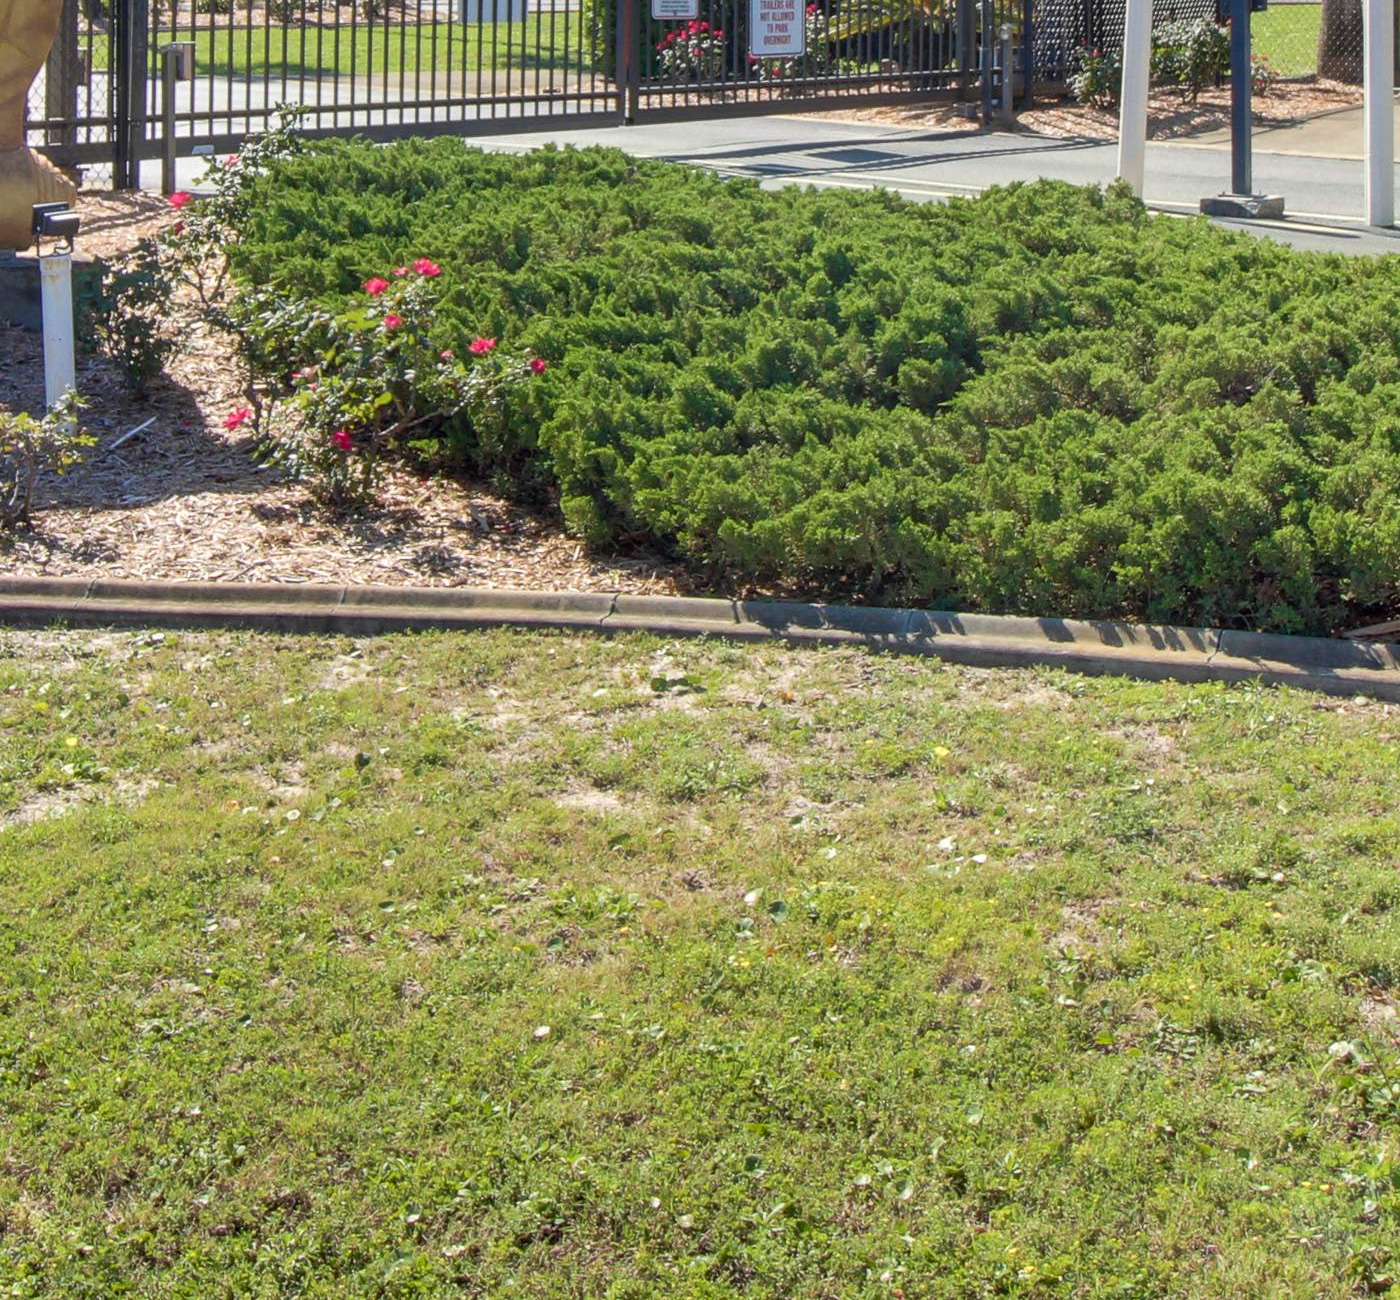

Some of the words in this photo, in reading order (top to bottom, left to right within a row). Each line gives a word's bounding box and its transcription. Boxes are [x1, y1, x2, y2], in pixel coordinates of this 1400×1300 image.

[760, 0, 784, 9] TRAILERS
[785, 0, 795, 9] ARE
[760, 12, 770, 22] NOT
[771, 11, 795, 21] ALLOWED
[767, 23, 774, 33] TO
[775, 23, 788, 33] PARK
[763, 35, 791, 45] OVERNIGHT
